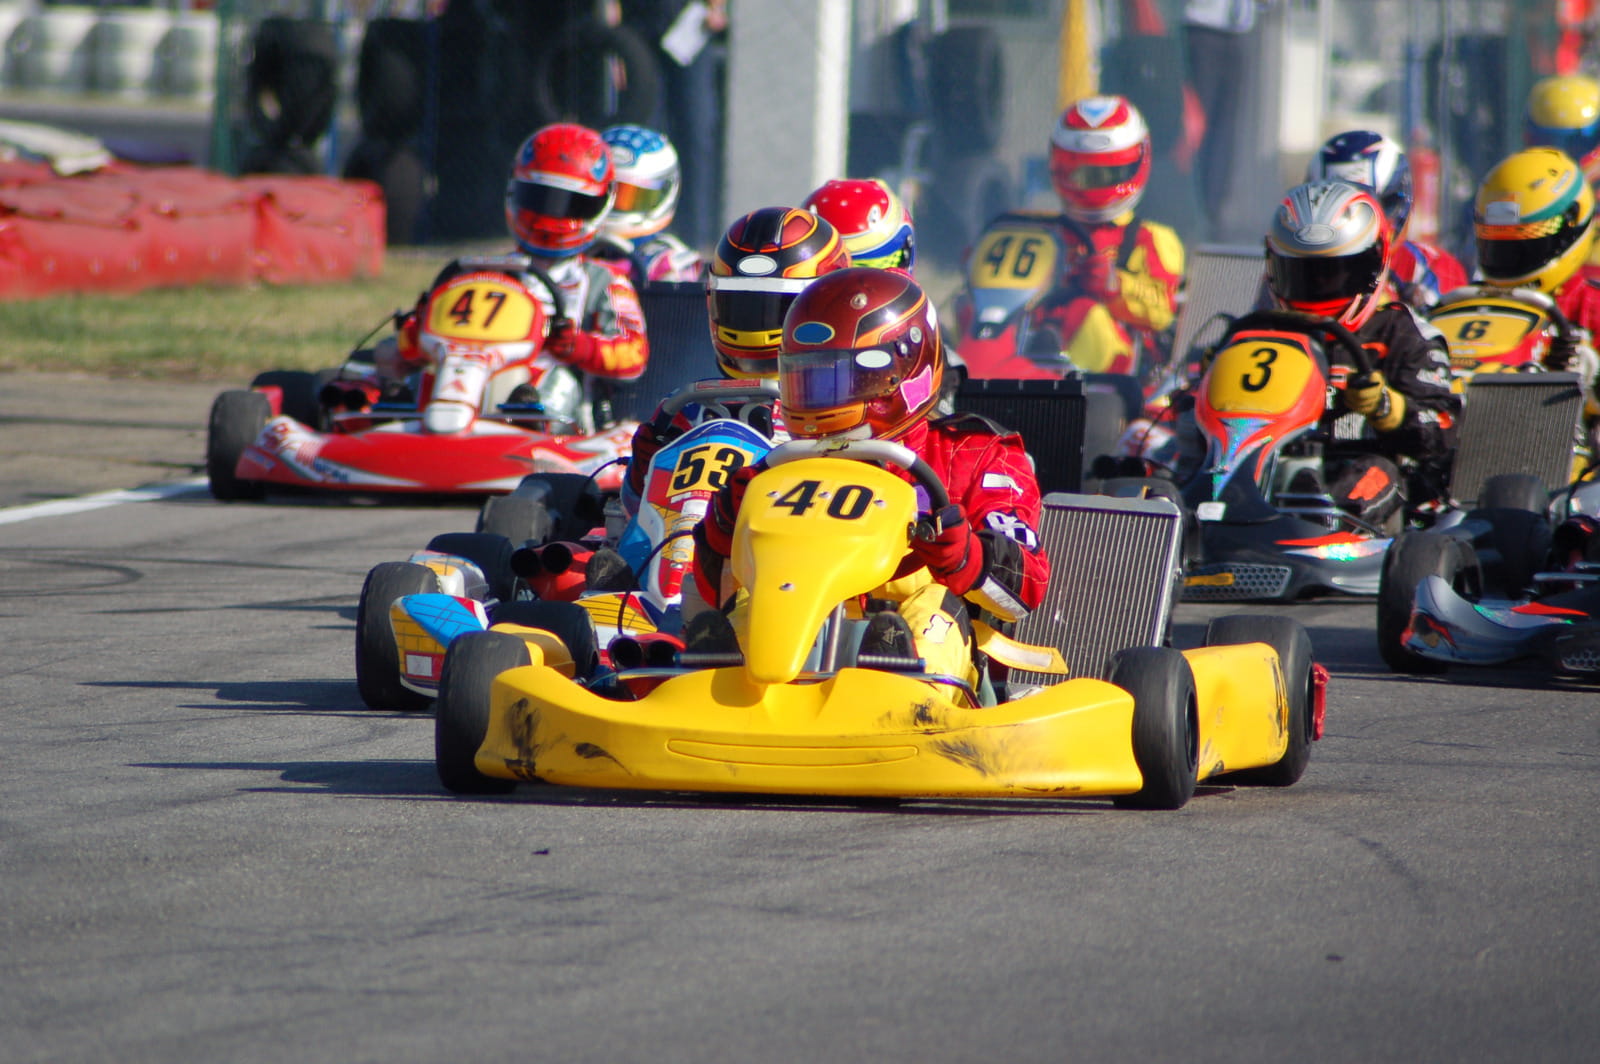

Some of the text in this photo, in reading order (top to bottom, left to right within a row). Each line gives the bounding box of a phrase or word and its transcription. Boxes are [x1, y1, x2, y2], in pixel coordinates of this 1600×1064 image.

[985, 235, 1043, 278] 46
[449, 289, 507, 328] 47
[1458, 320, 1491, 341] 6
[1241, 347, 1278, 393] 3
[673, 445, 745, 491] 53
[772, 480, 874, 521] 40
